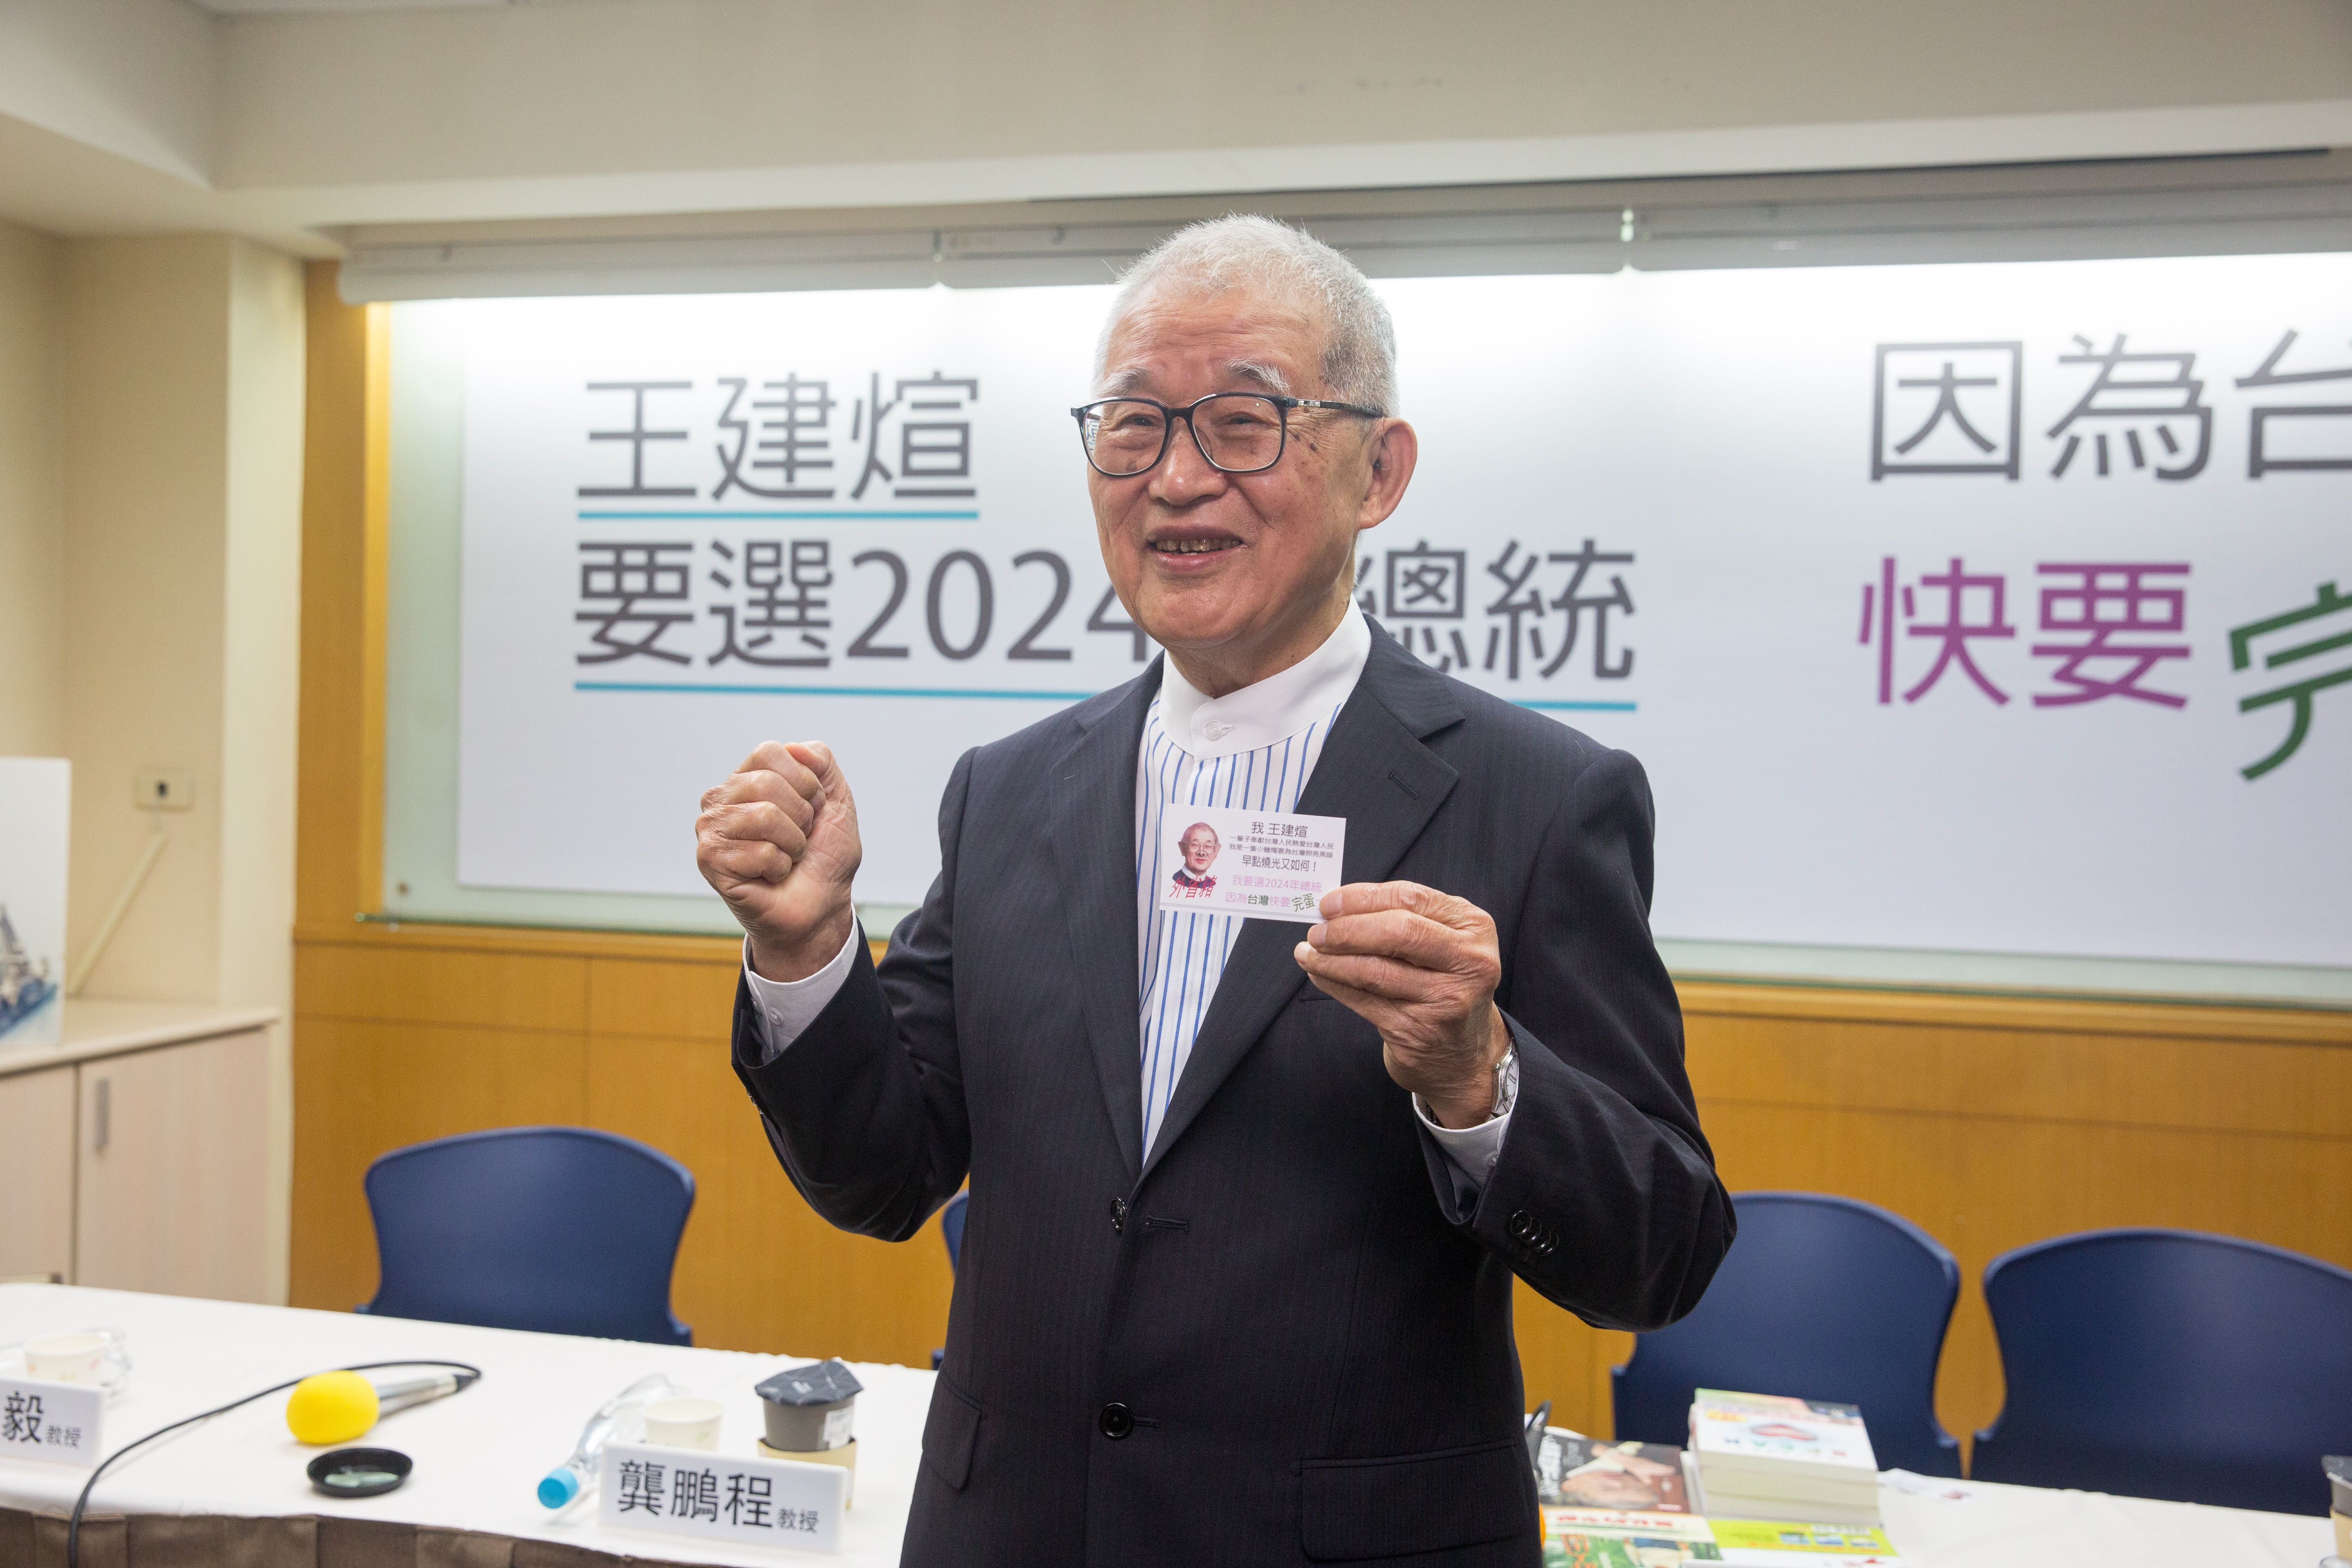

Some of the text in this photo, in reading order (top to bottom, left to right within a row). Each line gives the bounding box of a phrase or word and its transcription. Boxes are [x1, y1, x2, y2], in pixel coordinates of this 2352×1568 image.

[576, 369, 980, 501] 王建煊
[1267, 823, 1308, 838] 王建煊
[1232, 875, 1322, 893] 我要選2024年總統
